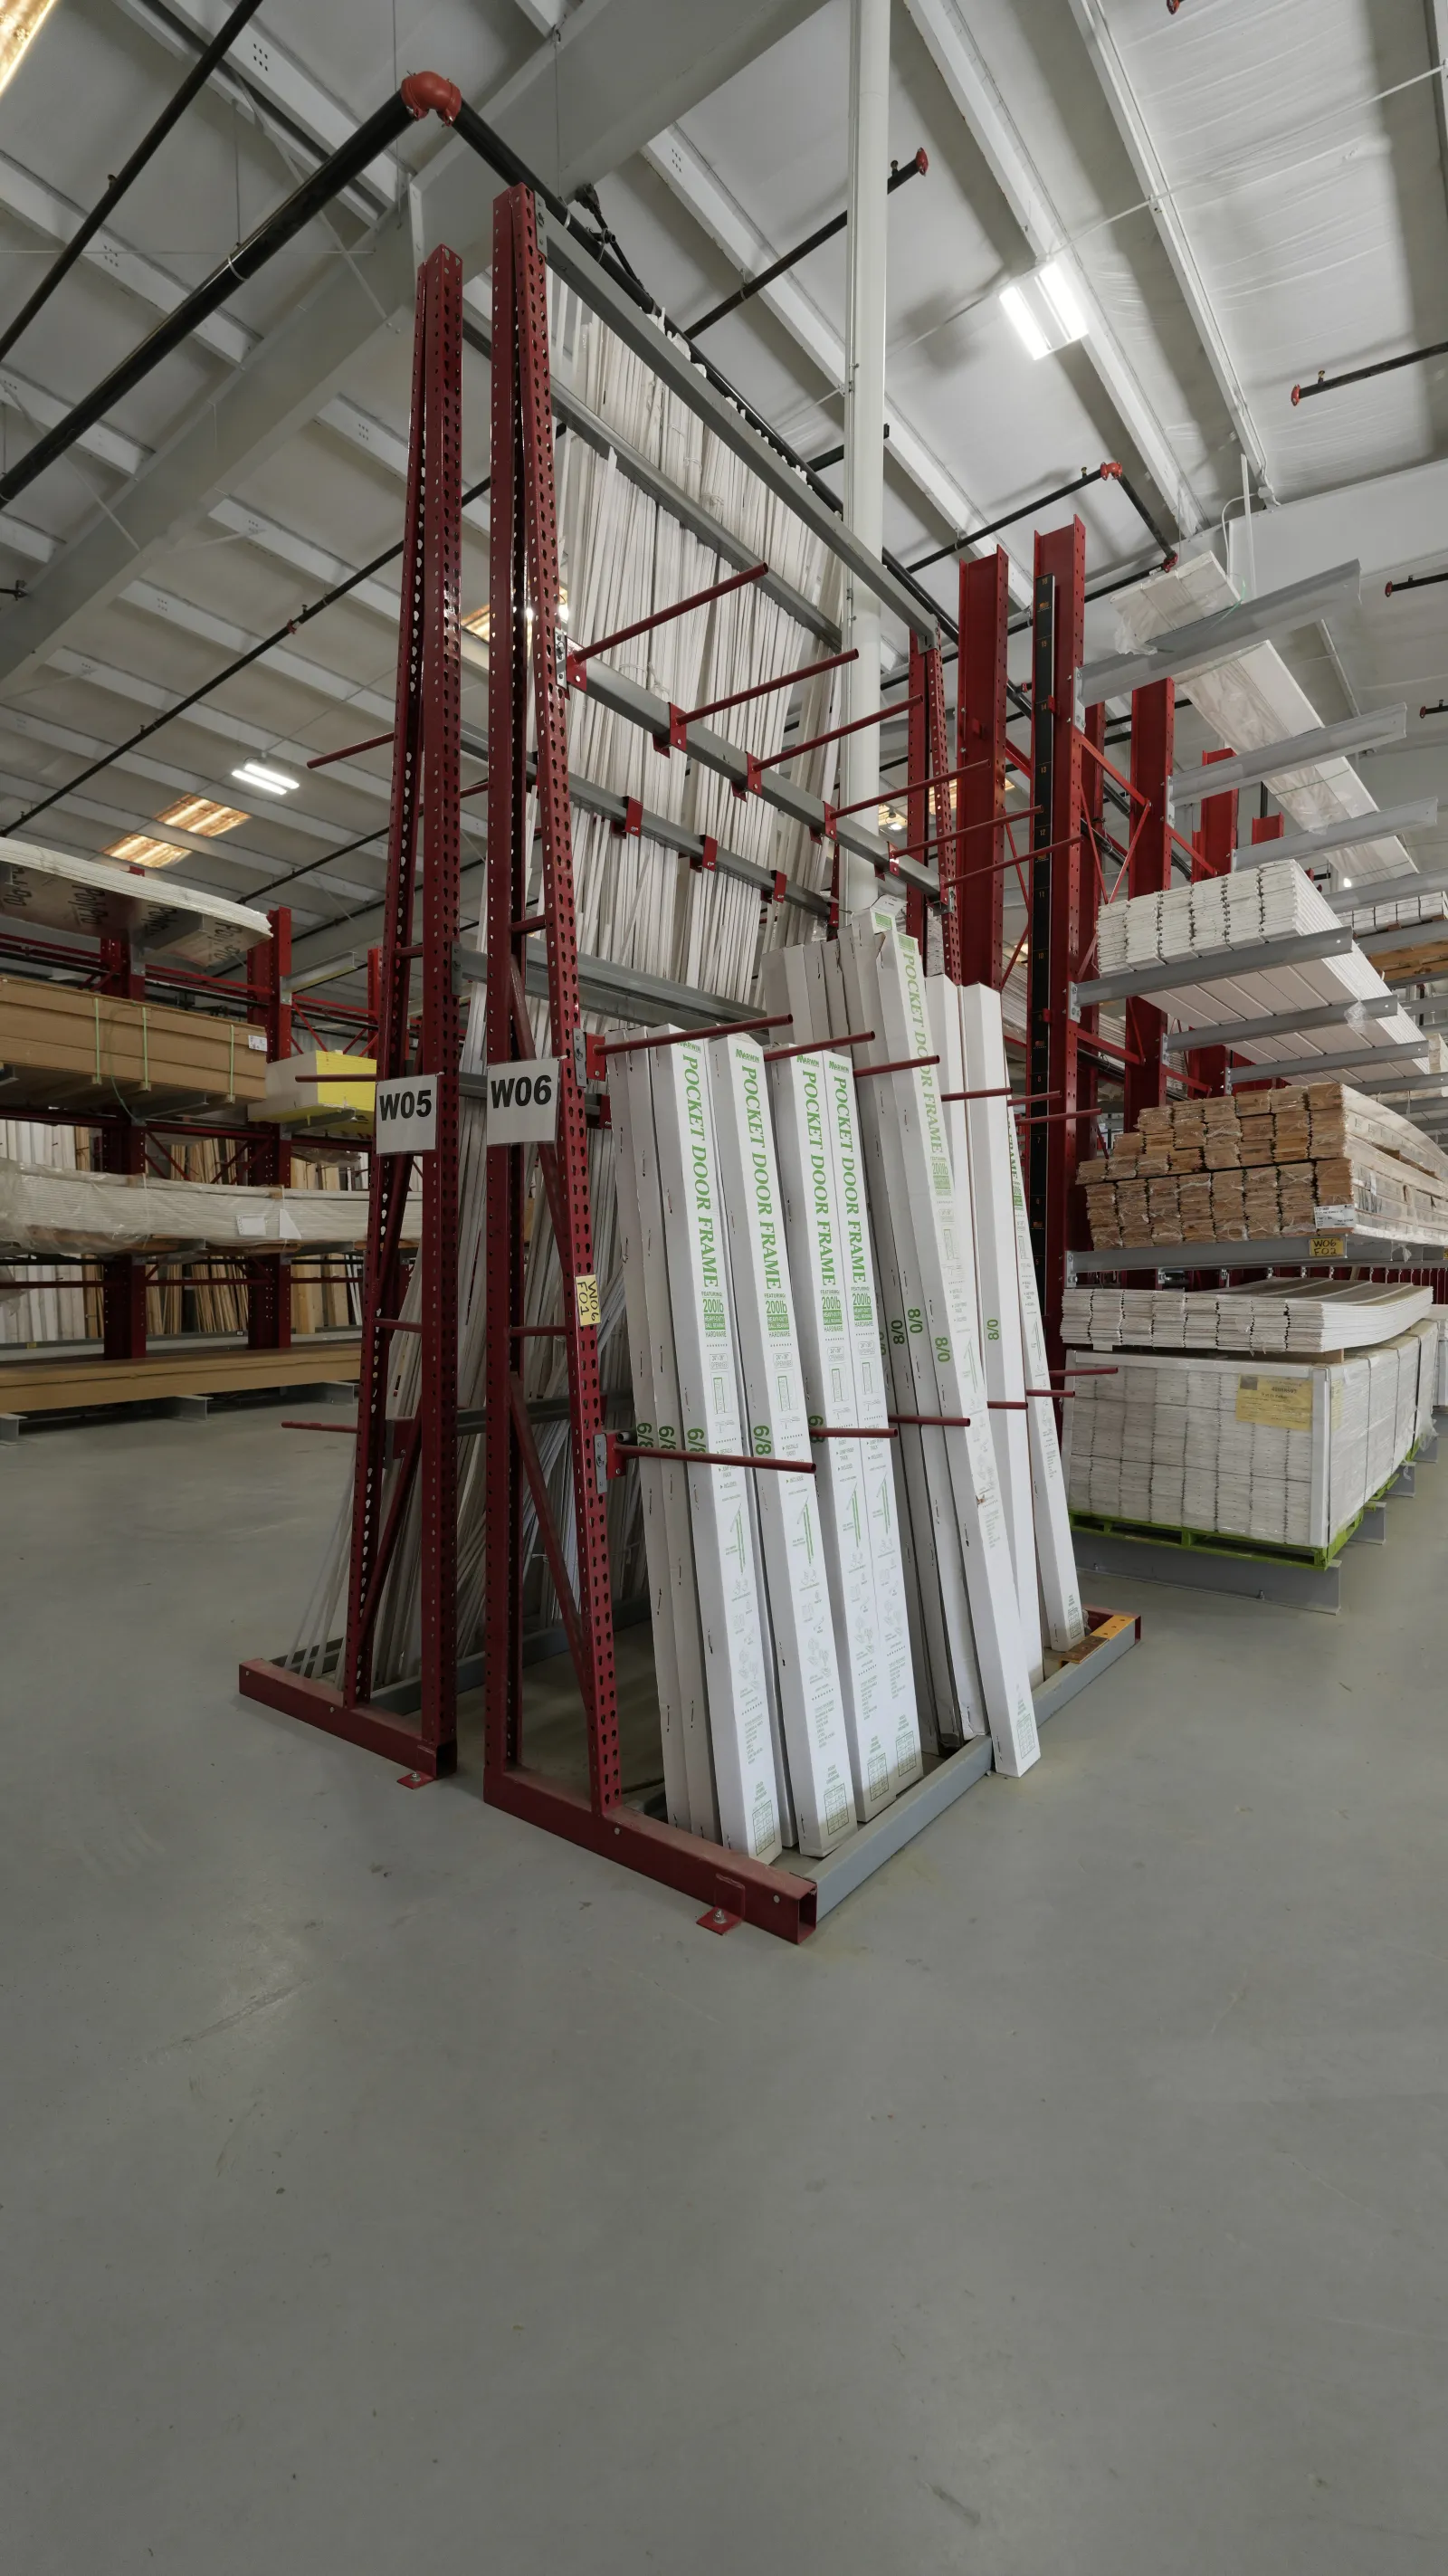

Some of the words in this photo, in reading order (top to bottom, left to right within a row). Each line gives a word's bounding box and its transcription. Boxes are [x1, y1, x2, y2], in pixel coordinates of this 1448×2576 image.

[736, 1048, 760, 1064] MARWIN
[796, 1055, 819, 1068] MARWIN
[829, 1060, 849, 1073] MARWIN
[903, 953, 924, 1027] POCKET
[923, 1092, 943, 1153] FRAME
[379, 1090, 433, 1121] W05
[491, 1074, 552, 1109] W06
[683, 1054, 705, 1140] POCKET
[742, 1065, 765, 1148] POCKET
[803, 1070, 823, 1150] POCKET
[834, 1076, 853, 1152] POCKET
[692, 1144, 711, 1210] DOOR
[752, 1152, 773, 1215] DOOR
[811, 1154, 828, 1215] DOOR
[842, 1157, 859, 1215] DOOR
[698, 1216, 719, 1287] FRAME
[760, 1221, 782, 1289] FRAME
[817, 1220, 835, 1285] FRAME
[848, 1220, 866, 1283] FRAME
[1313, 1239, 1337, 1247] W06
[577, 1282, 589, 1315] F01
[588, 1280, 599, 1321] W06
[703, 1298, 724, 1313] 200lb
[766, 1300, 787, 1313] 200lb
[822, 1296, 841, 1309] 200lb
[853, 1293, 872, 1305] 200lb
[891, 1320, 905, 1344] 8/0
[908, 1308, 923, 1333] 8/0
[987, 1319, 999, 1340] 8/0
[935, 1337, 950, 1362] 8/0
[753, 1426, 771, 1455] 6/8
